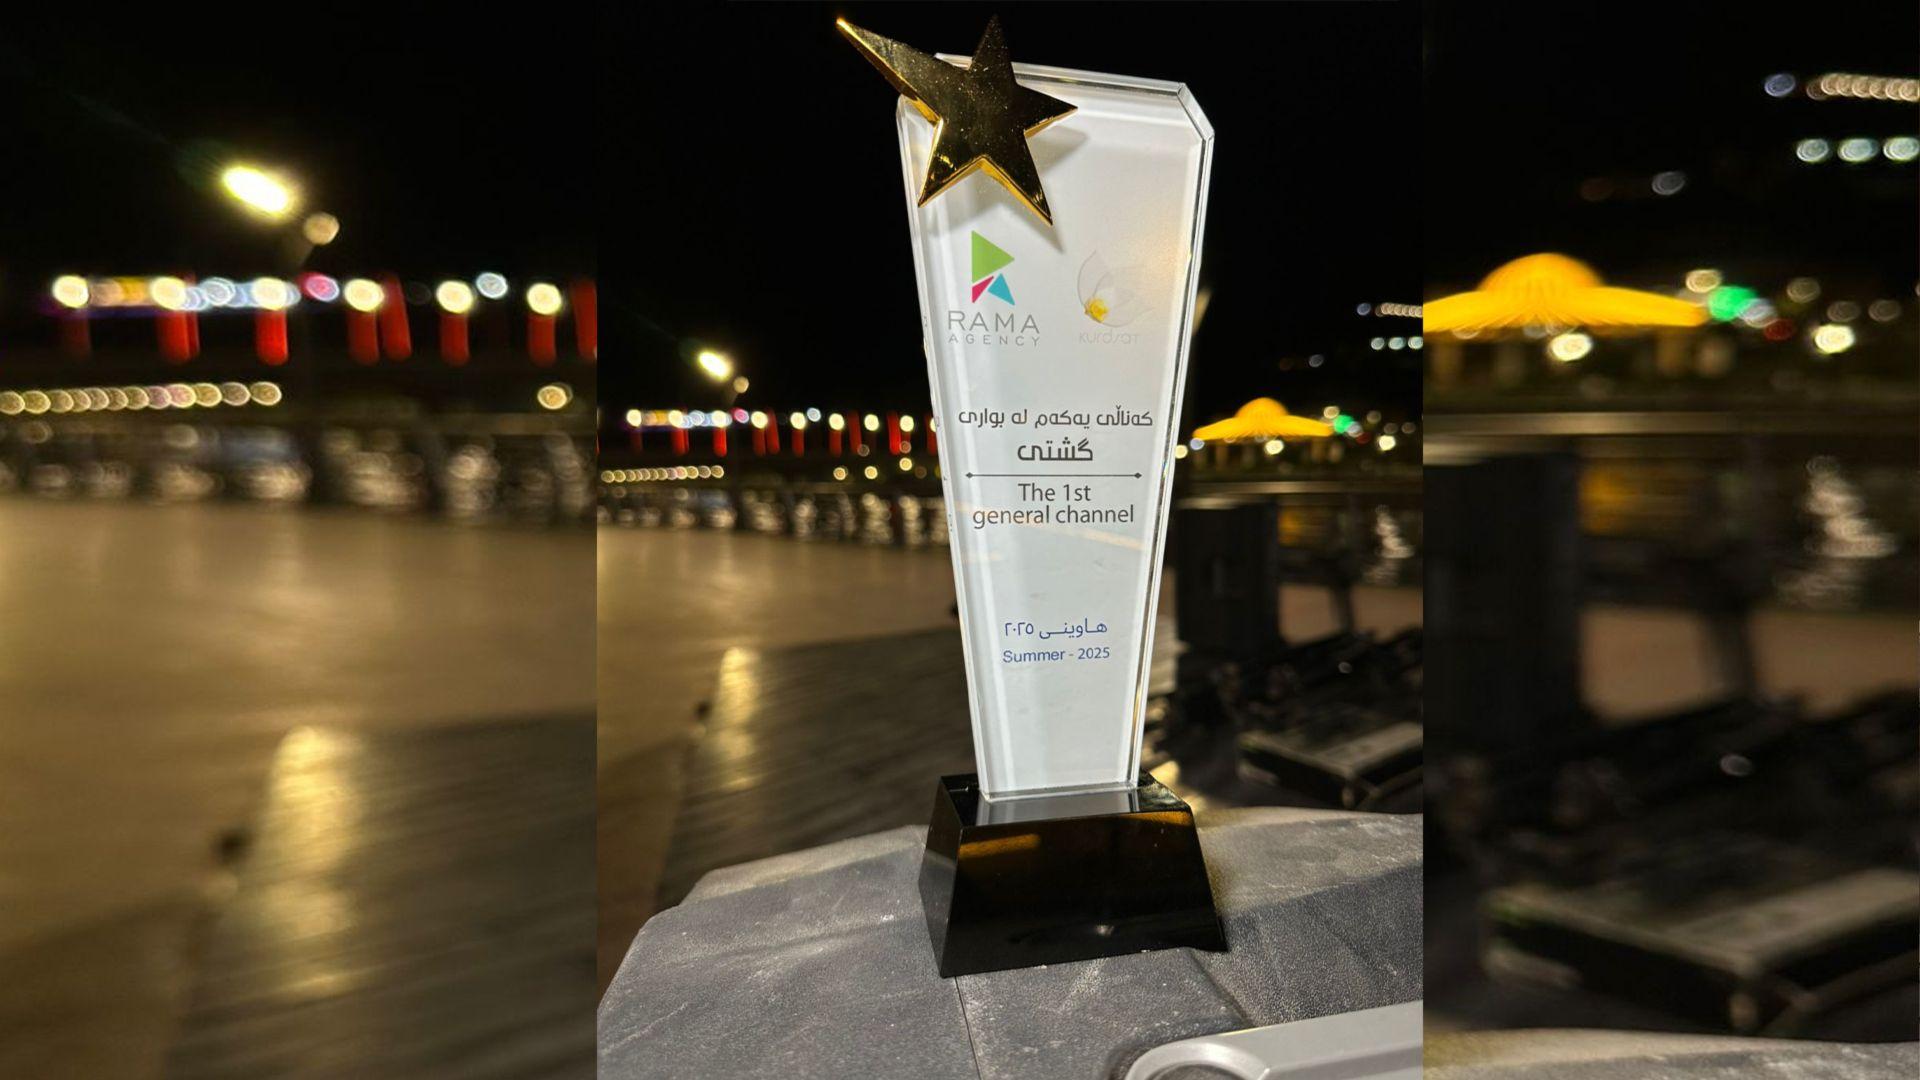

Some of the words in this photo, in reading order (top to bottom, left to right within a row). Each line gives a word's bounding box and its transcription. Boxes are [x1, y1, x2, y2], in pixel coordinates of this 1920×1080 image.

[948, 310, 1040, 334] RAMA
[948, 334, 1041, 347] AGENCY
[1018, 483, 1056, 501] The
[1062, 484, 1091, 501] 1st
[973, 505, 1050, 529] general
[1055, 504, 1134, 524] channel
[1003, 650, 1066, 663] Summer
[1077, 647, 1110, 660] 2025
